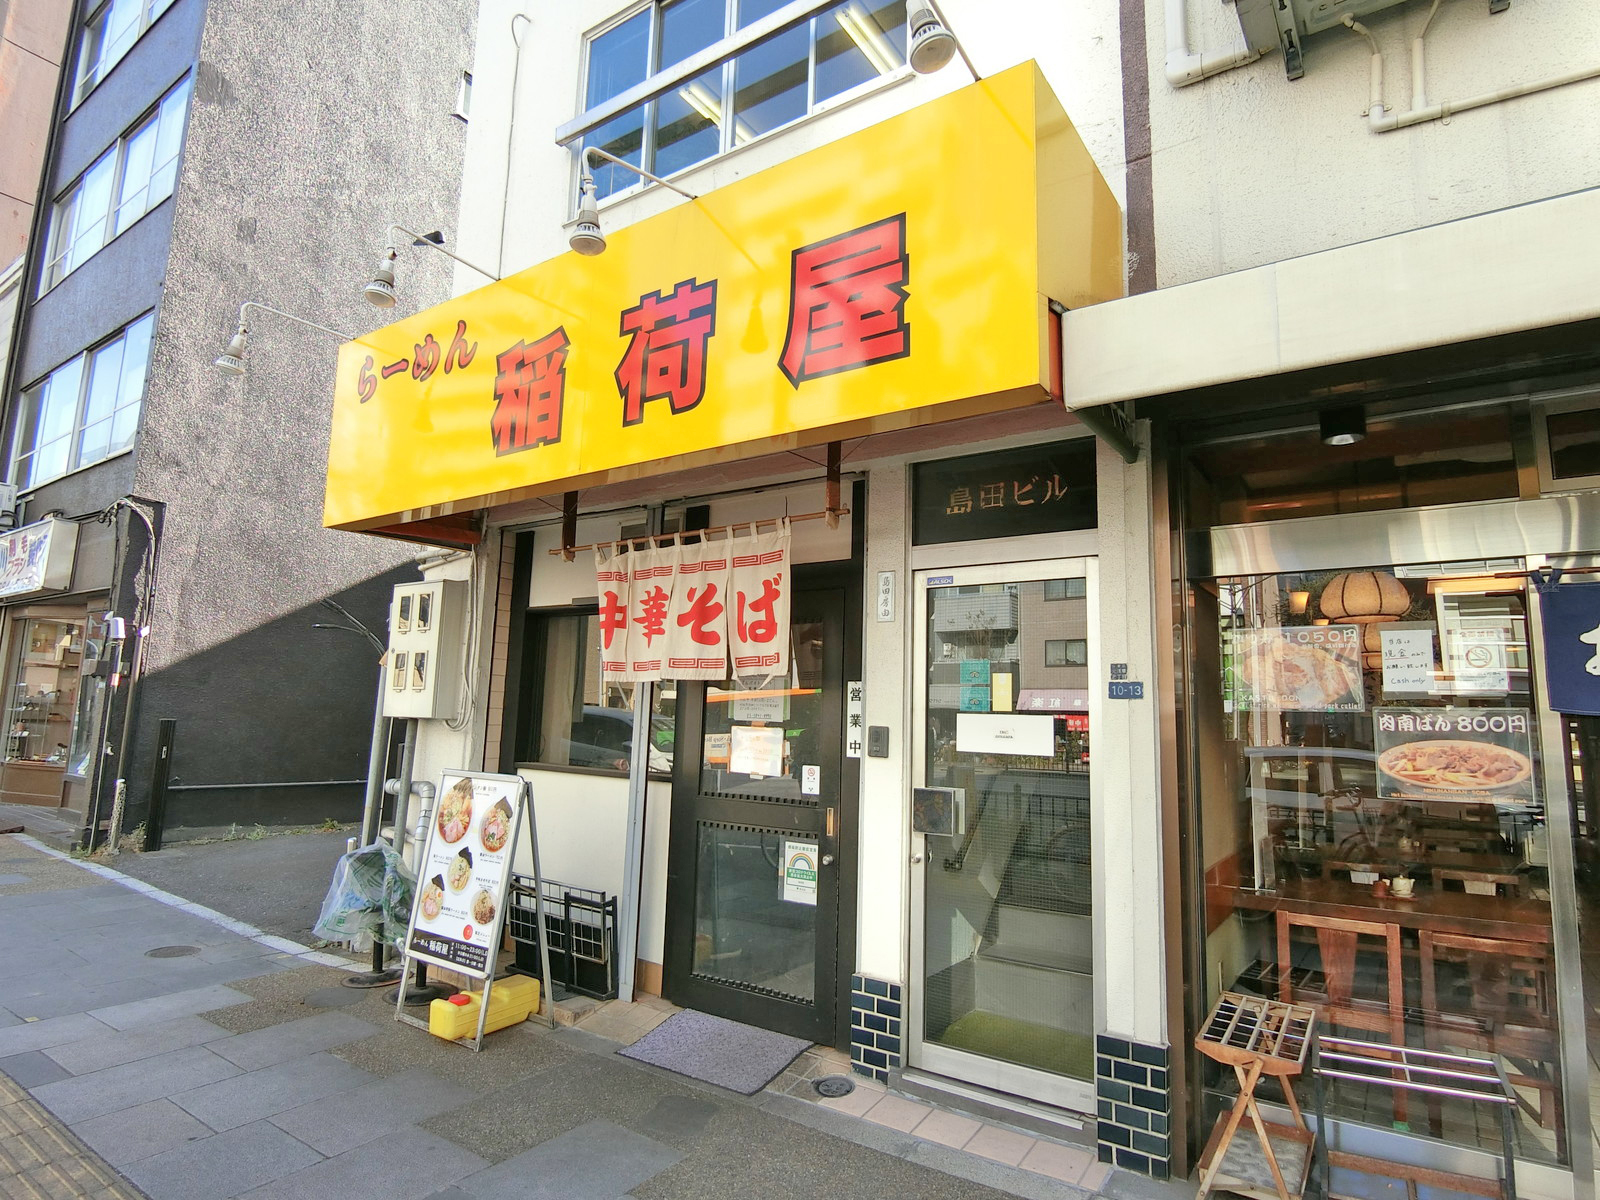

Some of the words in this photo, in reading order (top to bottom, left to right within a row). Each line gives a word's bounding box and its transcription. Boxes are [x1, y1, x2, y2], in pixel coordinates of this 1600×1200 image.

[358, 320, 478, 404] らーめん
[491, 211, 911, 458] 稲荷屋
[946, 474, 1068, 515] 島田ビル
[599, 572, 783, 650] 中華そば
[1285, 628, 1358, 643] 1050円
[1111, 685, 1142, 696] 10-13
[1411, 677, 1426, 685] only
[849, 687, 862, 755] 営業中
[1379, 713, 1450, 732] 肉南ばん
[1457, 715, 1526, 733] 800円
